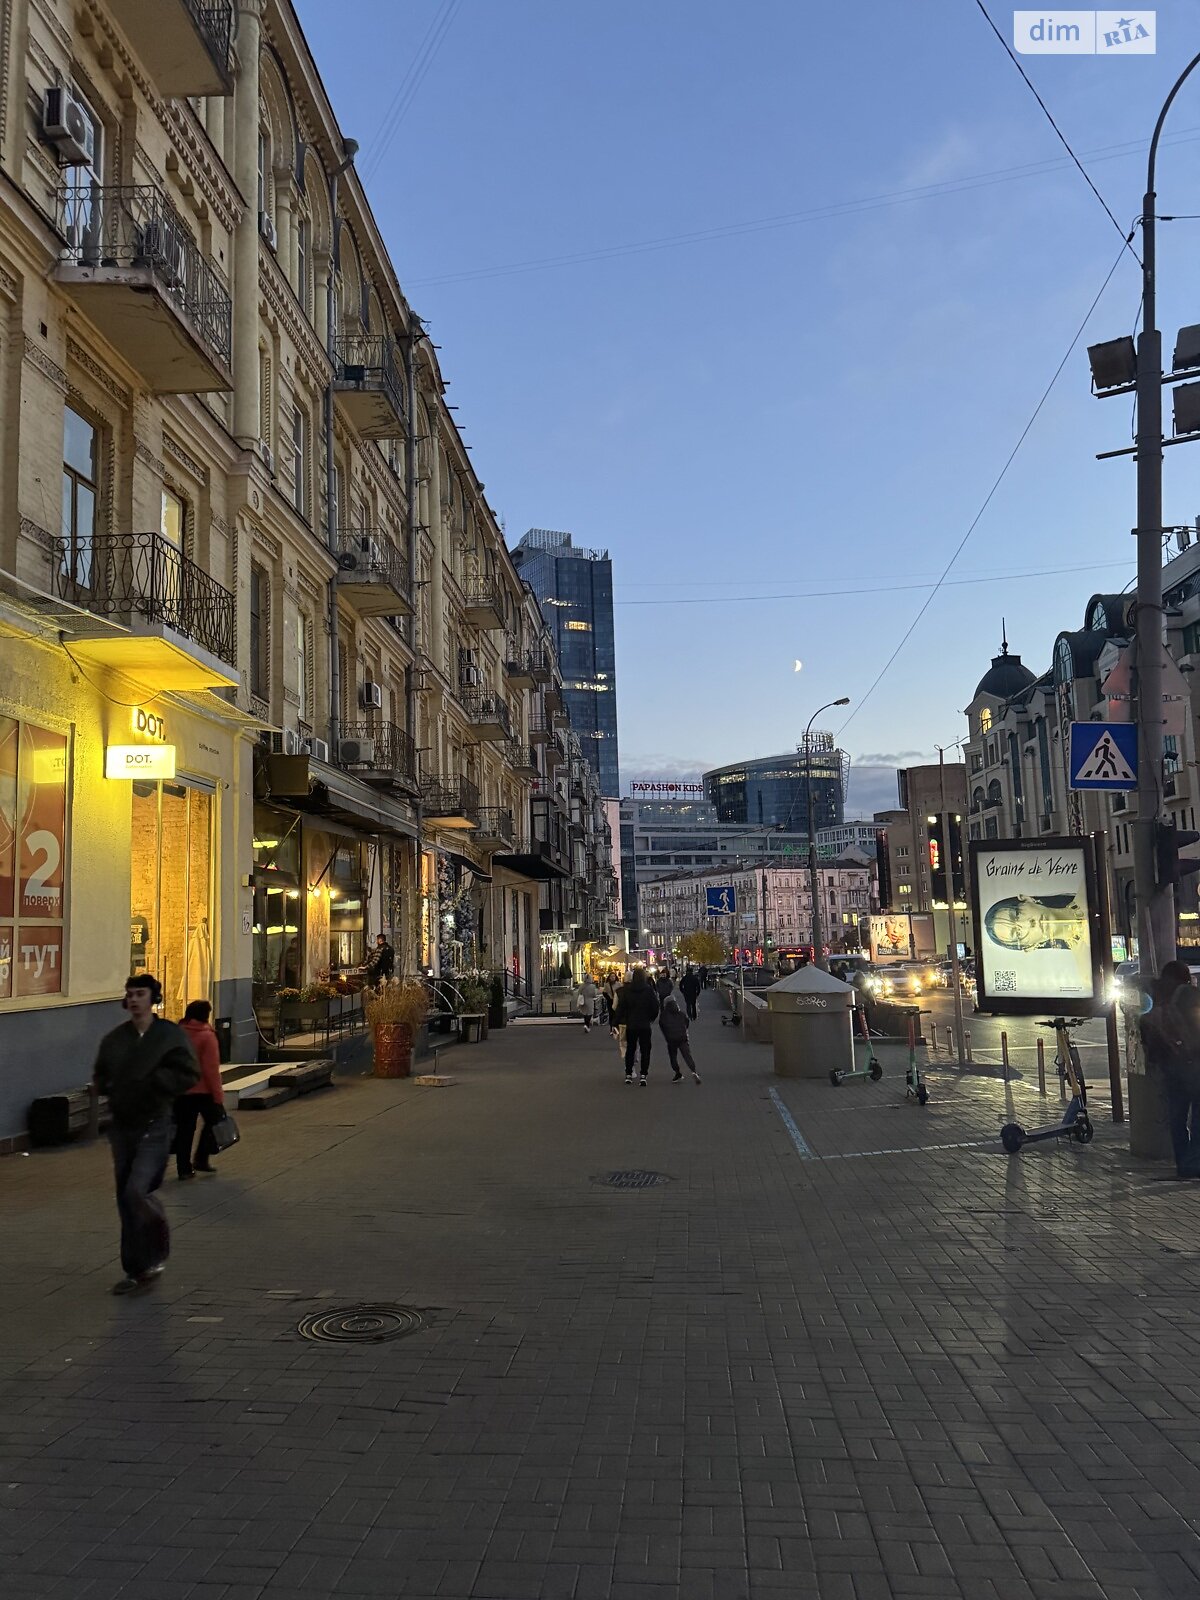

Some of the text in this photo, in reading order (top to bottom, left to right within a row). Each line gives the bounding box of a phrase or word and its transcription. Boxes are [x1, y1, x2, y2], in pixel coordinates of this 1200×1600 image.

[137, 708, 167, 741] DOT.
[126, 754, 153, 764] DOT.
[632, 783, 704, 792] PAPASHON KIDS
[25, 829, 61, 896] 2
[985, 857, 1078, 877] Grains de Verre
[24, 894, 61, 912] поверх
[21, 944, 59, 979] тут
